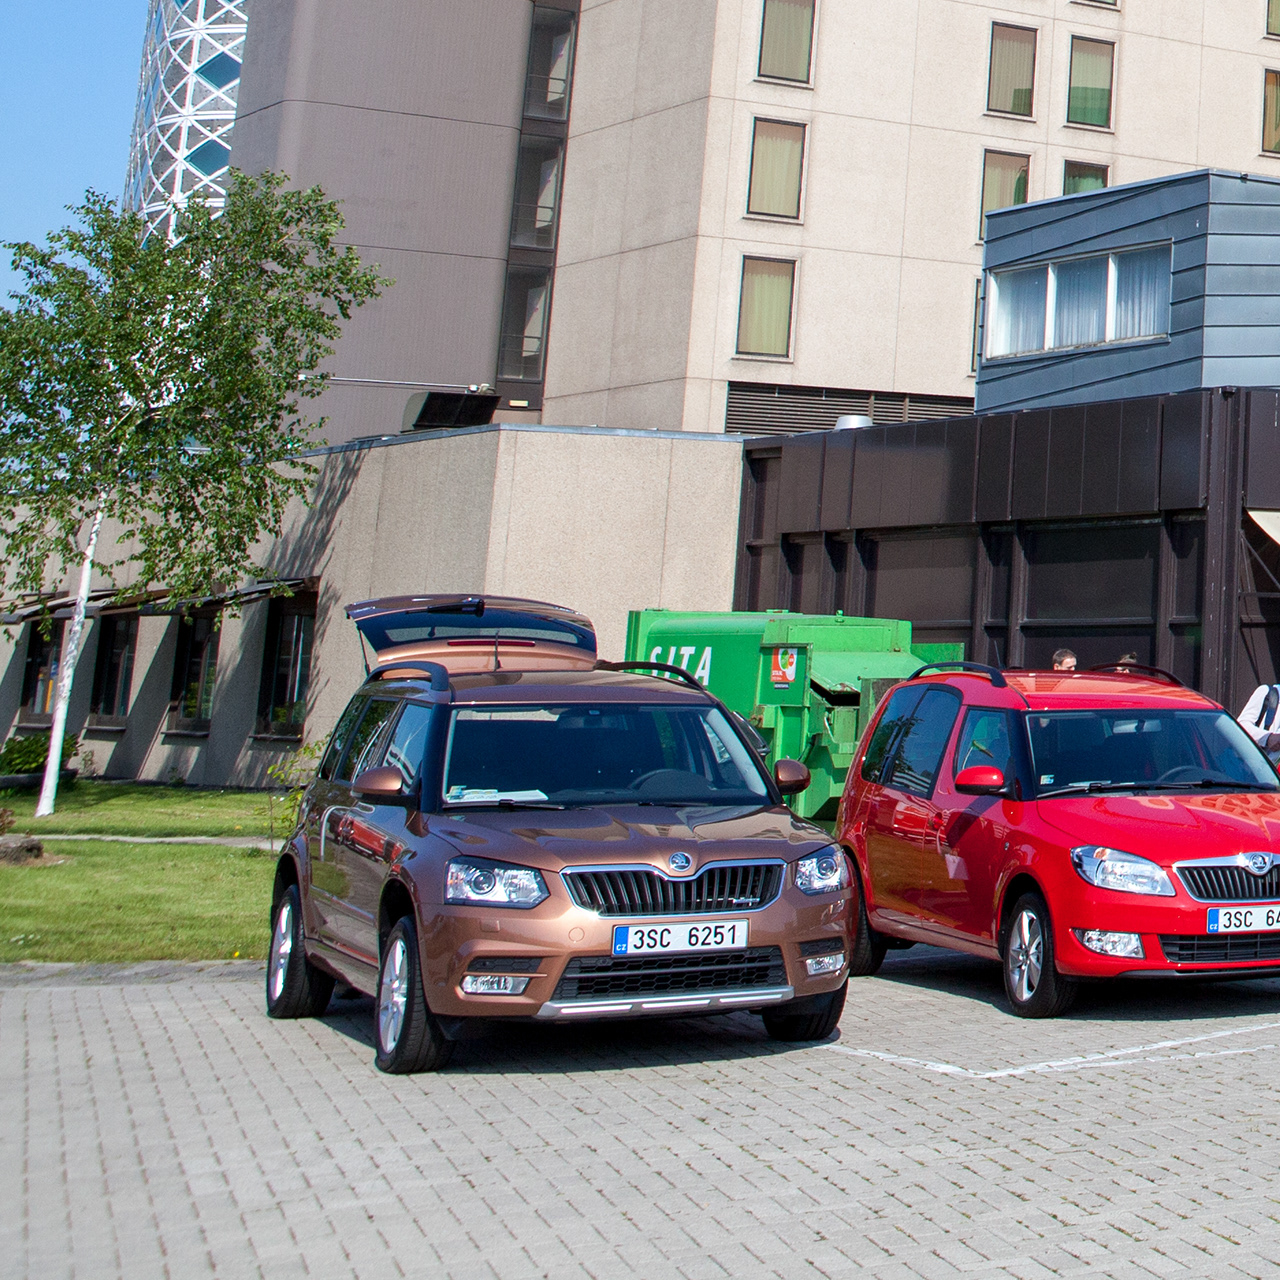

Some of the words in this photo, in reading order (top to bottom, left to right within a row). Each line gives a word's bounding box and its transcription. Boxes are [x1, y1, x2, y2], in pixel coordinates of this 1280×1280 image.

[650, 646, 712, 686] SITA
[1223, 910, 1253, 929] 3SC
[633, 928, 672, 950] 3SC
[688, 925, 737, 947] 6251
